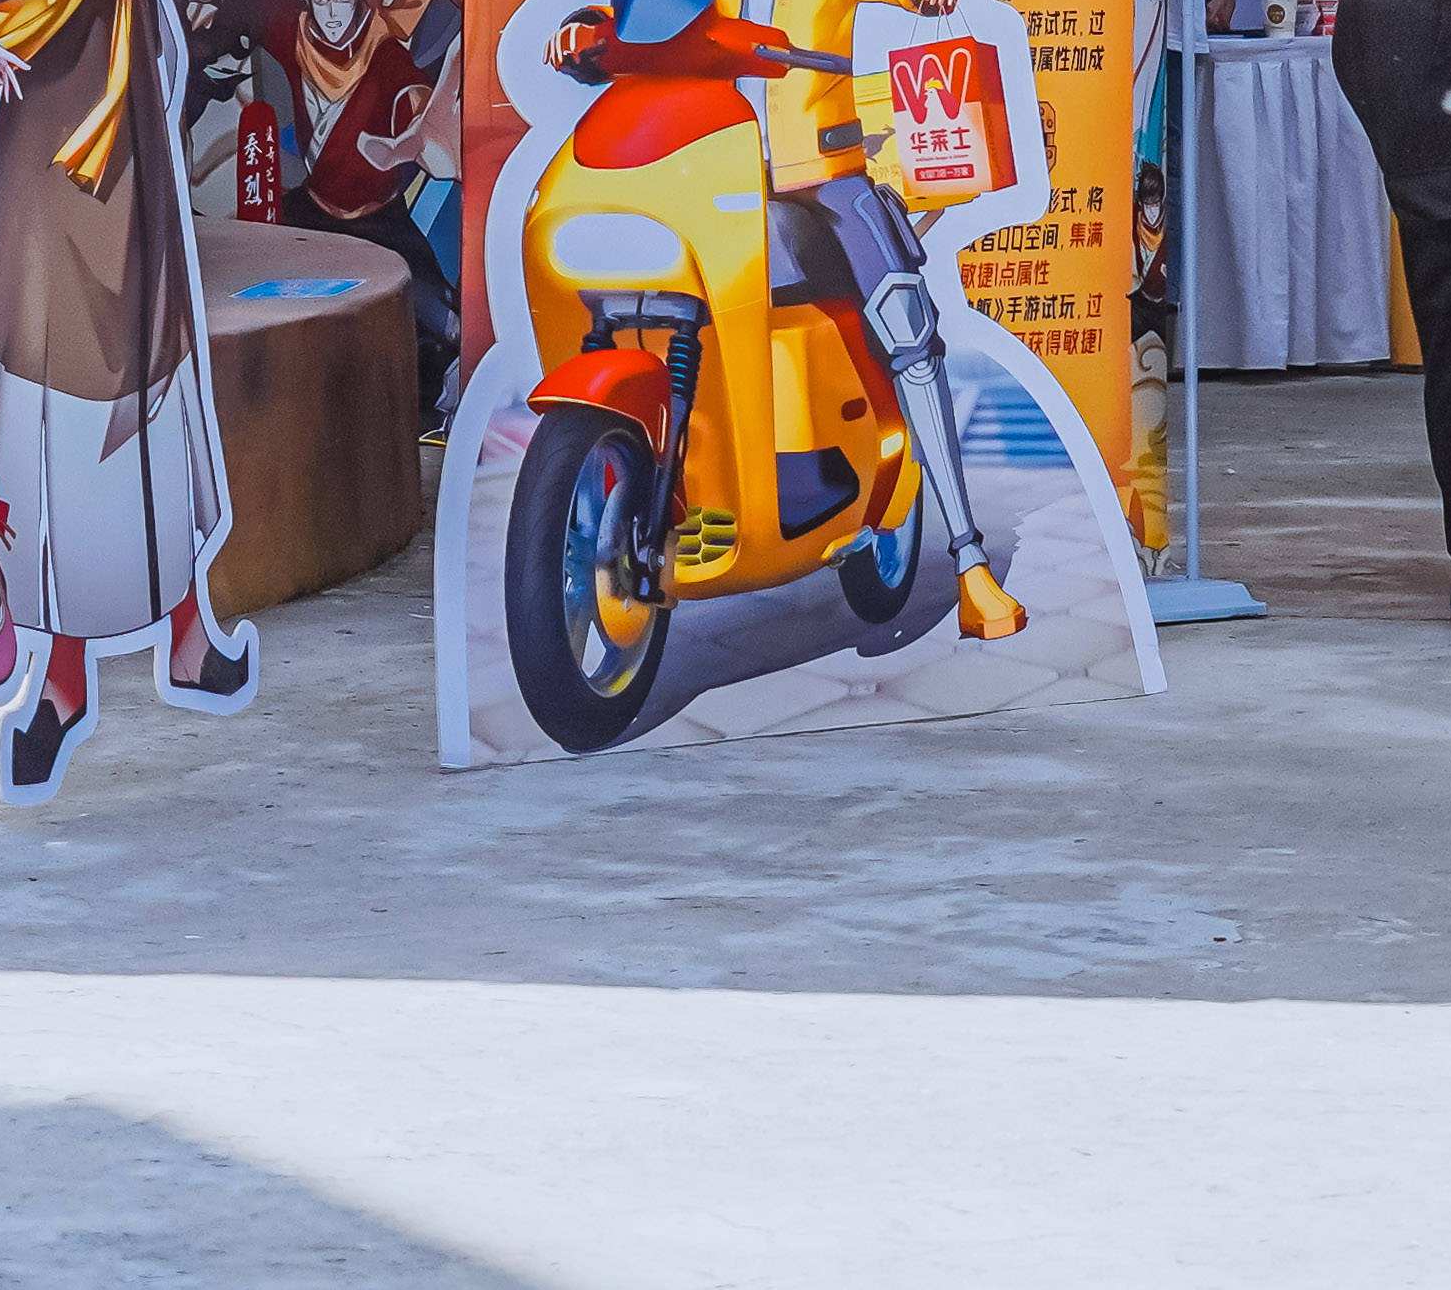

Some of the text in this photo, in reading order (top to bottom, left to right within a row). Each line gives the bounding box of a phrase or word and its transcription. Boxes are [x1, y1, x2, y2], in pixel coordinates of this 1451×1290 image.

[1019, 10, 1107, 37] 游试玩，过
[909, 126, 972, 154] 华莱士
